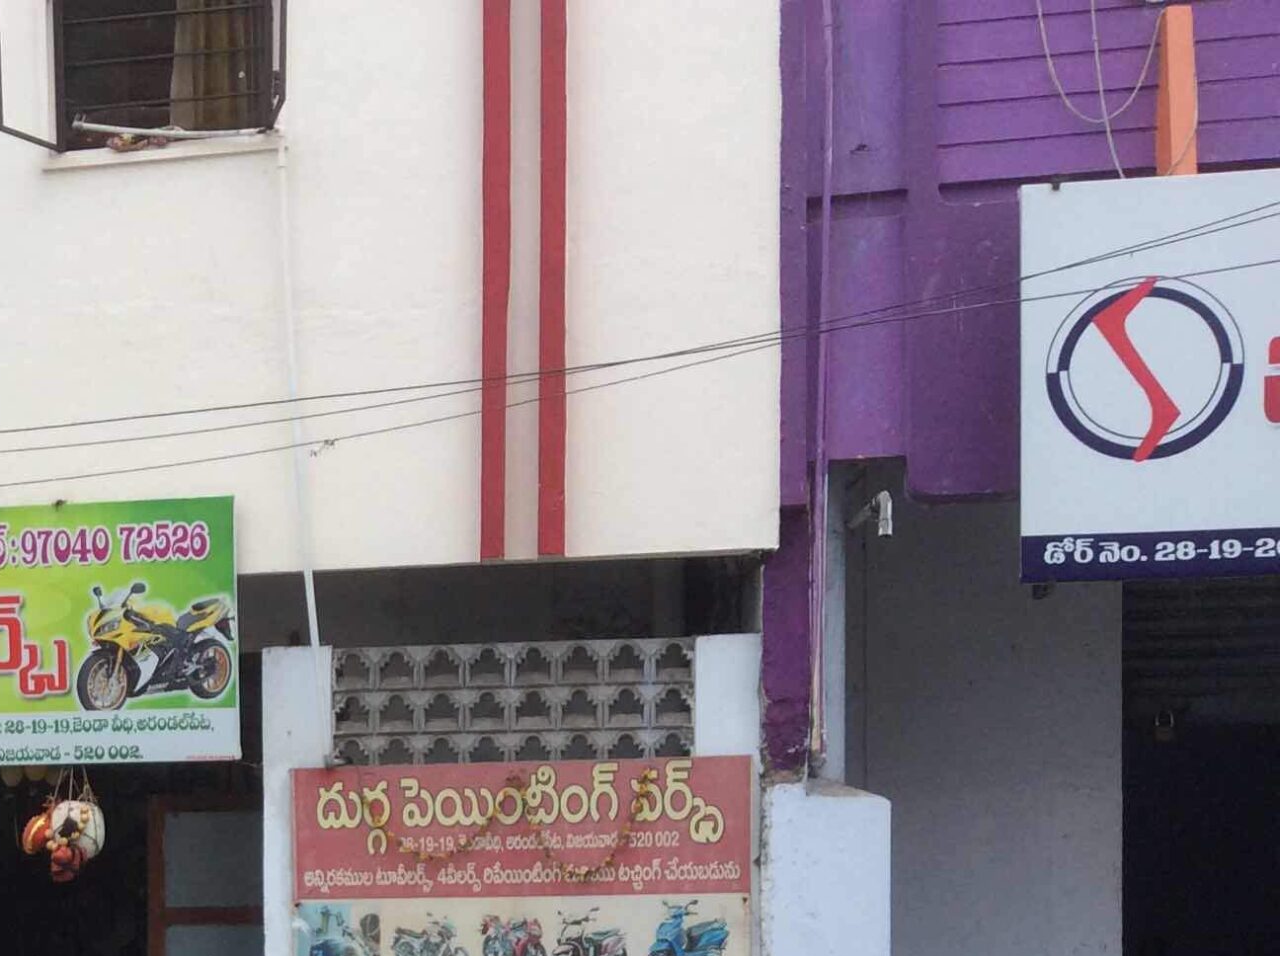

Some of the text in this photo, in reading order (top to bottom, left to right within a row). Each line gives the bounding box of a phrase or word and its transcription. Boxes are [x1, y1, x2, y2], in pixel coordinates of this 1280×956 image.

[119, 523, 208, 561] 72526
[1044, 537, 1094, 564] డోర్
[1154, 538, 1280, 561] 28-19-2
[74, 745, 105, 760] 520
[317, 782, 391, 855] దుర్గ
[400, 762, 618, 829] పెయింటింగ్
